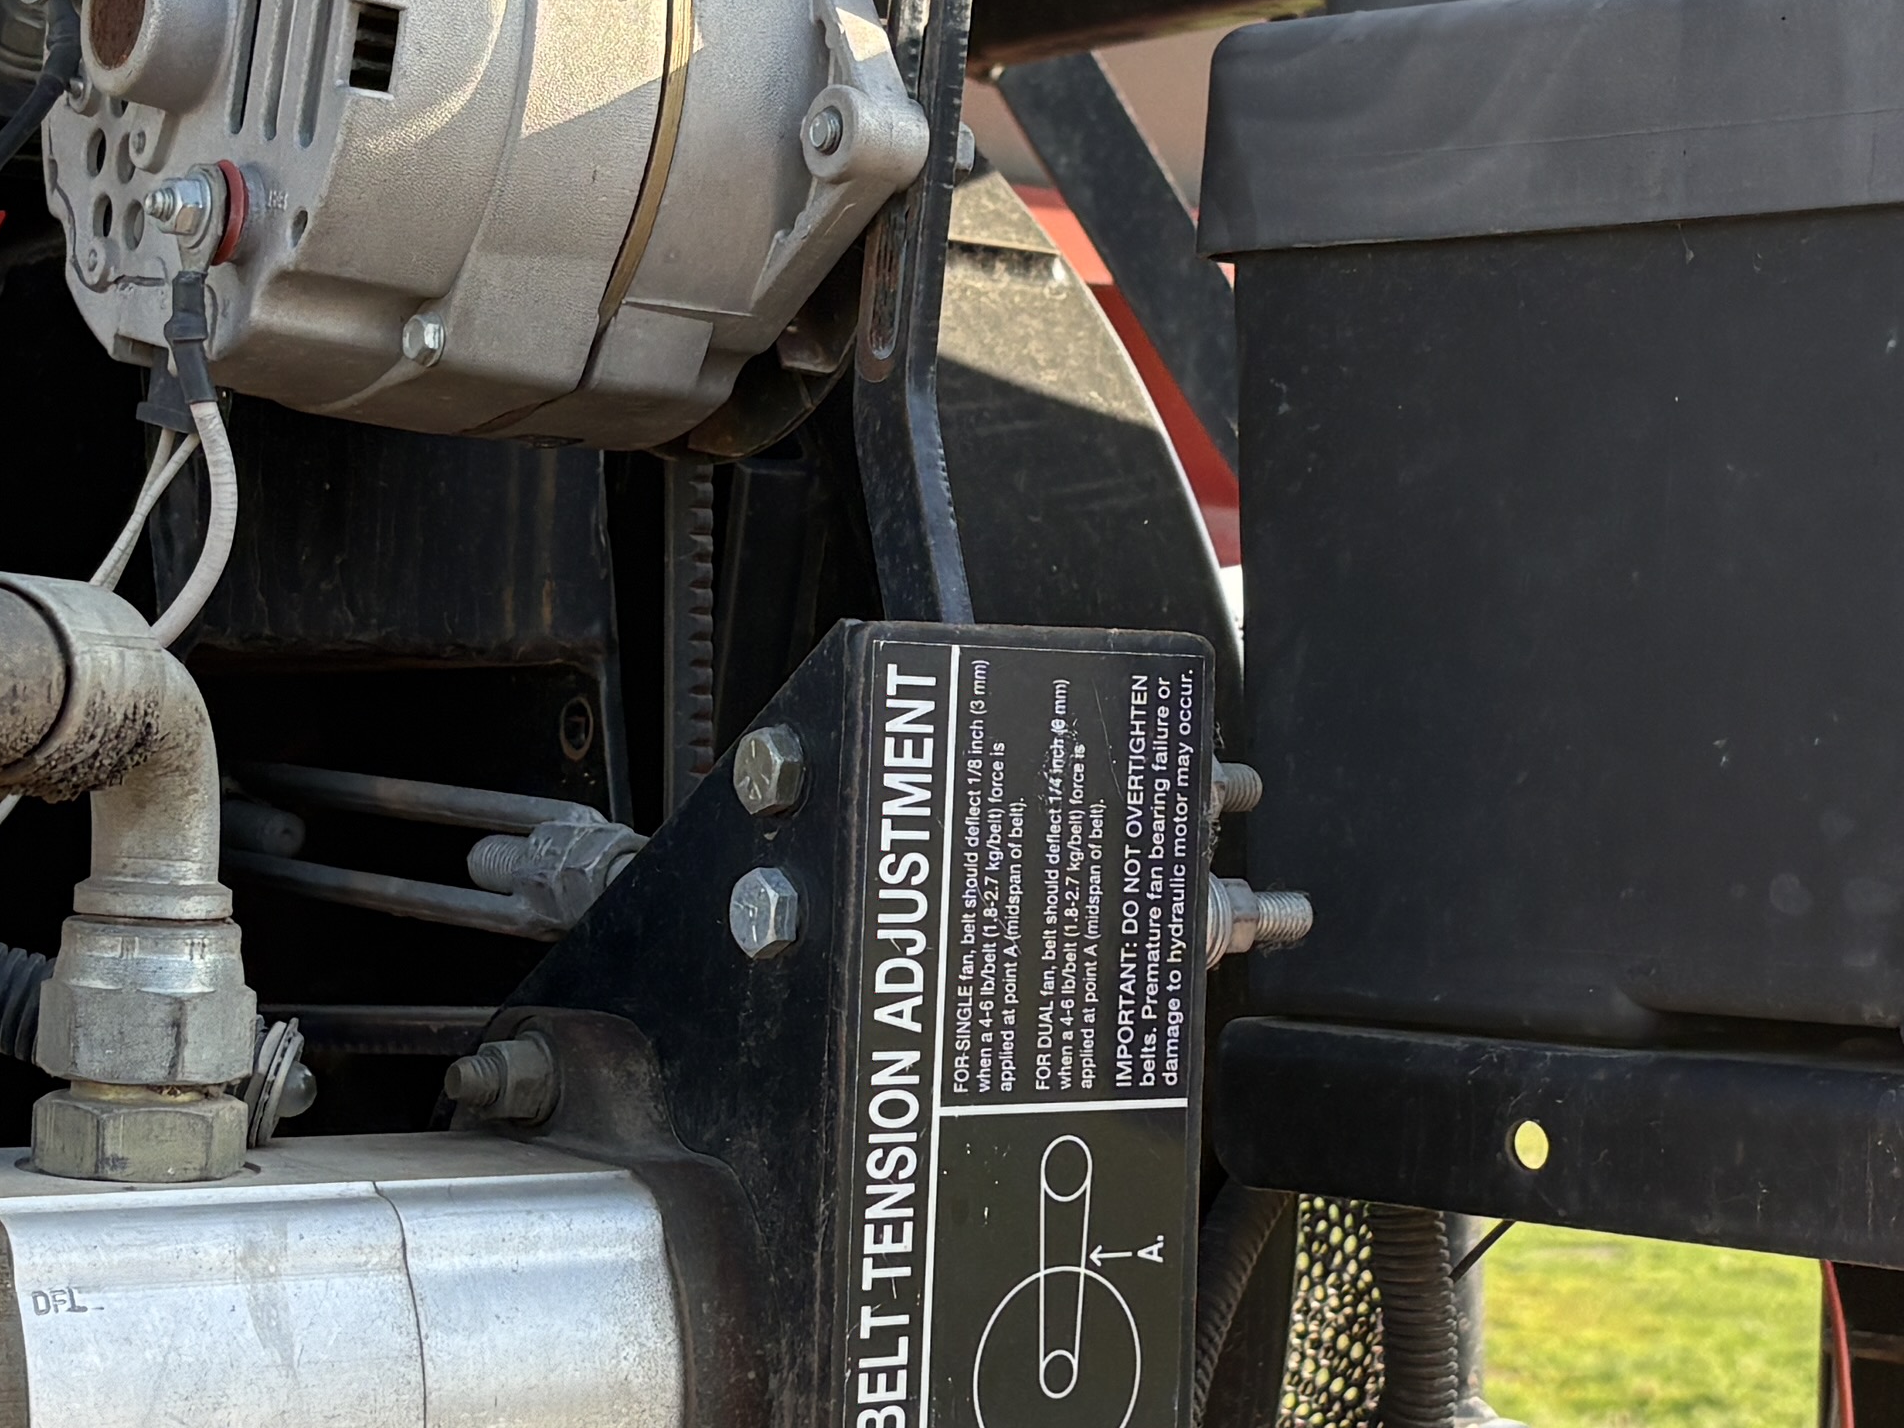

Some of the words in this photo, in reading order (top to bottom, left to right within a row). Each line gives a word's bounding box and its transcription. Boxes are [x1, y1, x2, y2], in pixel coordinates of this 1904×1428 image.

[971, 659, 987, 695] mm)
[1052, 679, 1068, 715] mm)
[1157, 676, 1171, 700] or
[969, 699, 986, 715] (3
[1178, 669, 1193, 736] occur.
[967, 719, 985, 755] inch
[989, 742, 1005, 757] is
[1048, 736, 1065, 775] inch
[1069, 741, 1086, 759] is
[1125, 675, 1147, 839] OVERTIGHTEN
[1151, 705, 1170, 772] failure
[967, 759, 983, 786] 1/8
[987, 760, 1005, 803] force
[1068, 762, 1085, 805] force
[1177, 741, 1191, 787] may
[964, 789, 982, 848] deflect
[985, 807, 1003, 871] kg/belt)
[1007, 797, 1025, 839] belt).
[1045, 807, 1063, 865] deflect
[1087, 798, 1105, 839] belt).
[1149, 778, 1168, 859] bearing
[1172, 792, 1189, 858] motor
[873, 663, 938, 1034] ADJUSTMENT
[1007, 841, 1023, 860] of
[1065, 809, 1084, 872] kg/belt)
[1087, 843, 1103, 861] of
[962, 851, 979, 909] should
[1123, 843, 1141, 893] NOT
[1147, 866, 1164, 901] fan
[983, 875, 999, 938] (1.8-2.7
[1005, 863, 1023, 941] (midspan
[1043, 869, 1060, 925] should
[1063, 875, 1080, 937] (1.8-2.7
[1085, 864, 1102, 940] (midspan
[1122, 899, 1139, 935] DO
[1167, 863, 1186, 963] hydraulic
[960, 912, 977, 945] belt
[1041, 929, 1057, 961] belt
[1084, 943, 1099, 957] A
[959, 949, 977, 981] fan,
[981, 941, 997, 996] lb/belt
[1004, 944, 1020, 958] A
[1061, 941, 1078, 995] lb/belt
[1143, 906, 1162, 1020] Premature
[1003, 961, 1019, 1005] point
[1039, 965, 1057, 997] fan,
[1083, 960, 1099, 1003] point
[1166, 969, 1182, 993] to
[955, 984, 974, 1052] SINGLE
[980, 1000, 995, 1029] 4-6
[1001, 1008, 1016, 1026] at
[1037, 1000, 1054, 1049] DUAL
[1060, 998, 1075, 1027] 4-6
[1082, 1007, 1096, 1024] at
[1116, 942, 1138, 1087] IMPORTANT:
[980, 1031, 993, 1043] a
[1061, 1030, 1074, 1041] a
[1141, 1027, 1157, 1087] belts.
[1163, 997, 1182, 1087] damage
[954, 1055, 972, 1094] FOR
[978, 1047, 993, 1093] when
[1000, 1029, 1016, 1092] applied
[1036, 1053, 1052, 1091] FOR
[1058, 1045, 1073, 1091] when
[1080, 1028, 1097, 1089] applied
[861, 1050, 921, 1291] TENSION
